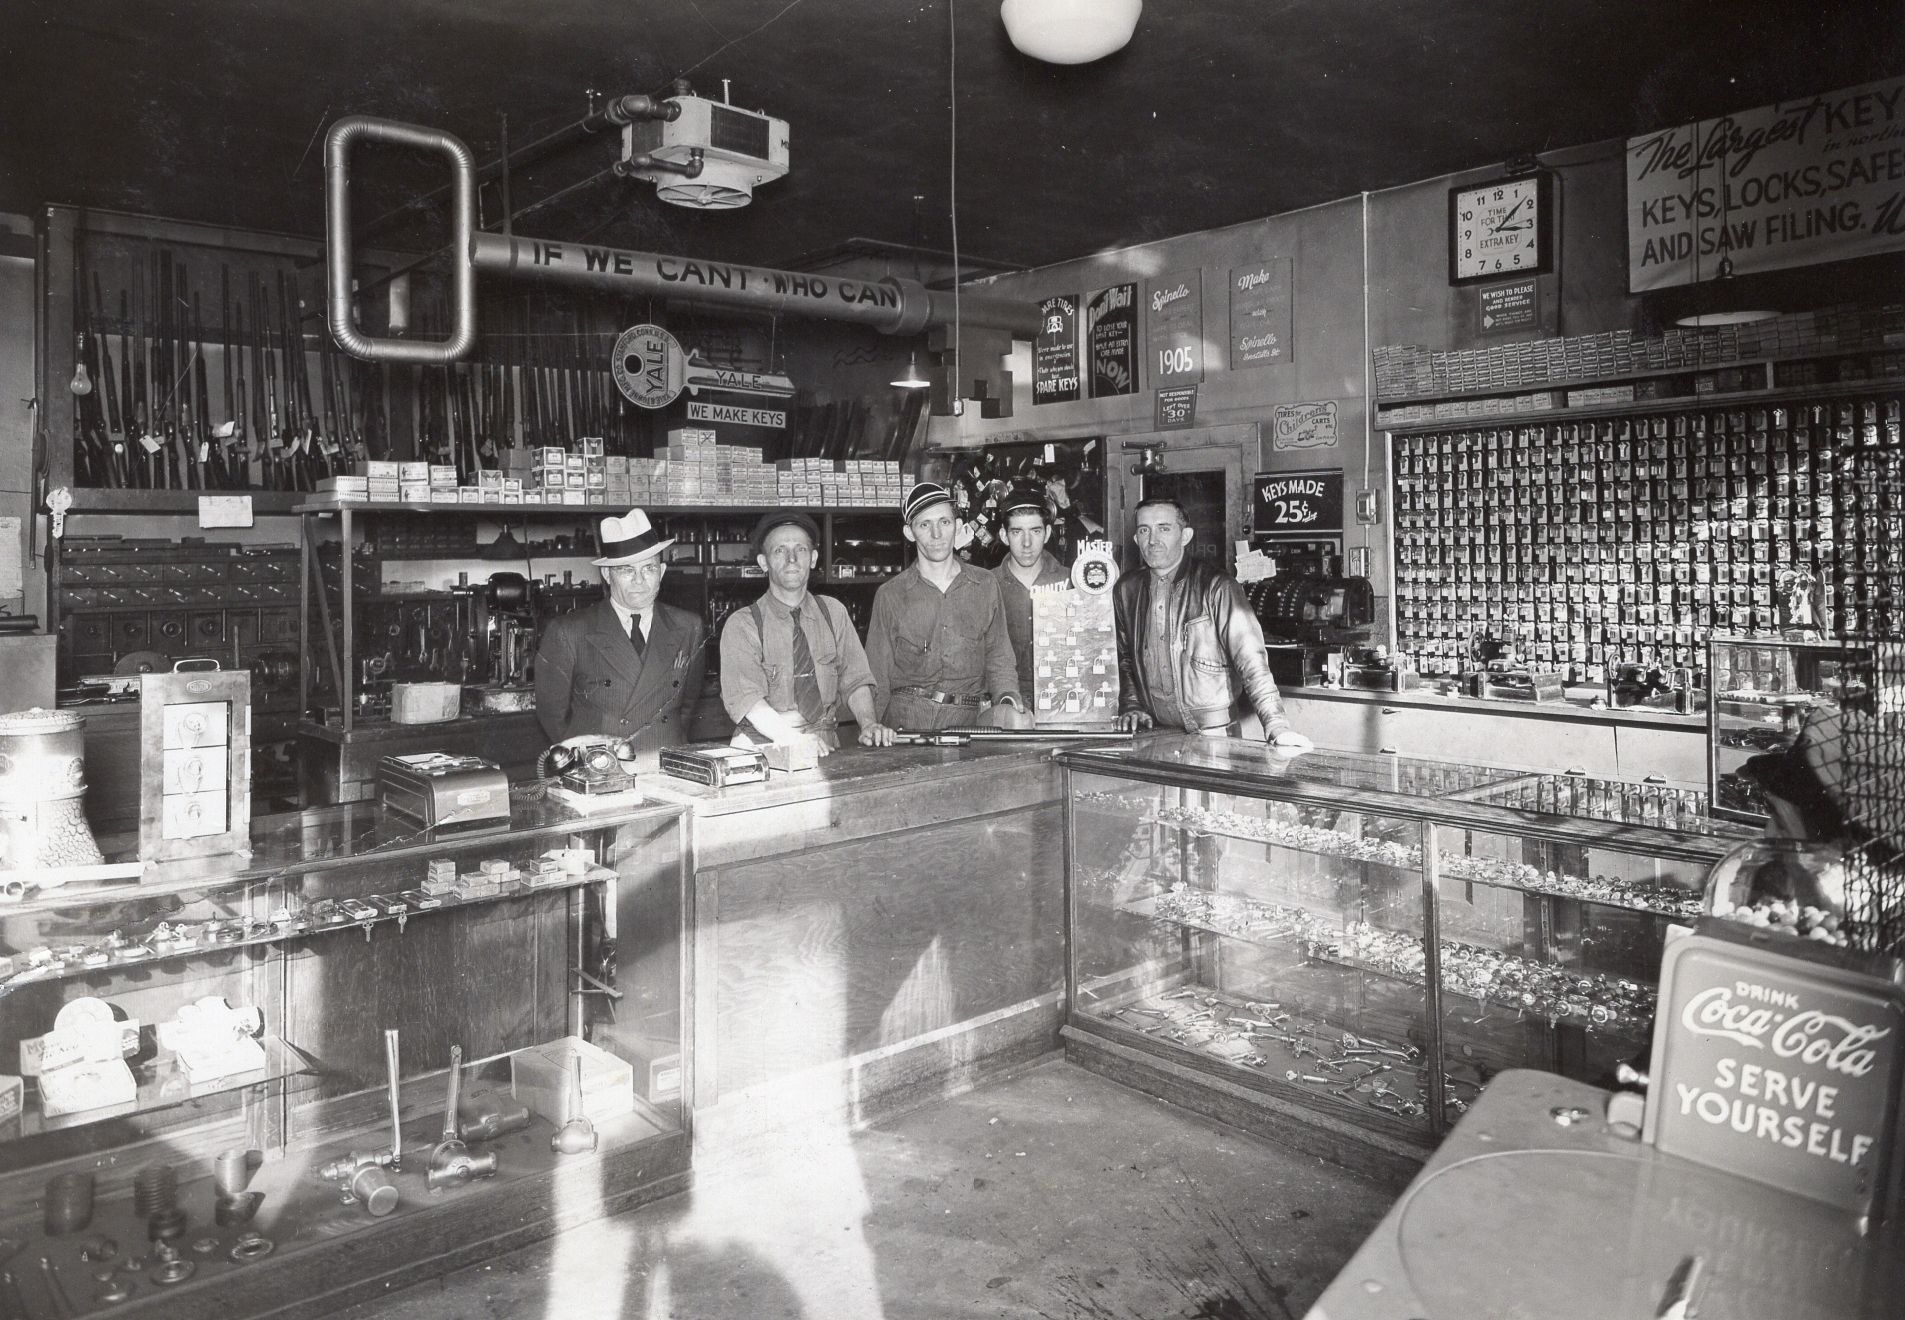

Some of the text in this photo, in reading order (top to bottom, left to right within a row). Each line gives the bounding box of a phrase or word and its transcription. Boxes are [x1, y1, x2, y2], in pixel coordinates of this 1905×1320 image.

[1636, 132, 1692, 180] The
[1678, 98, 1824, 179] Largest
[1493, 190, 1504, 201] 12
[1514, 189, 1518, 198] 1
[1642, 150, 1905, 228] KEYS, LOCKS, SAFE
[1477, 196, 1485, 206] 11
[1526, 199, 1534, 209] 2
[1462, 211, 1473, 222] 10
[1488, 207, 1507, 217] TIME
[1480, 216, 1495, 226] FOR
[1526, 219, 1534, 229] 3
[1465, 230, 1472, 240] 9
[1480, 233, 1519, 249] EXTRA KEY
[1641, 232, 1693, 267] AND
[1700, 220, 1757, 255] SAW
[1766, 201, 1867, 245] FILING.
[1526, 238, 1535, 248] 4
[1465, 249, 1472, 259] 8
[1514, 254, 1521, 265] 5
[1479, 260, 1487, 270] 7
[1495, 259, 1502, 270] 6
[533, 242, 562, 265] IF
[583, 247, 633, 275] WE
[772, 272, 828, 299] WHO
[839, 281, 898, 309] CAN
[1237, 269, 1270, 291] Make
[1108, 285, 1132, 311] Wait
[1152, 284, 1190, 312] Spinello
[1482, 284, 1534, 300] WE WISH TO PLEASE
[1057, 297, 1075, 316] TIRES
[1240, 333, 1277, 351] Spinello
[646, 340, 664, 397] YALE
[1159, 345, 1193, 375] 1905
[715, 370, 762, 390] YALE
[1096, 358, 1131, 389] NOW
[1036, 377, 1078, 394] SPARE KEYS
[690, 404, 784, 425] WE MAKE KEYS
[1163, 403, 1176, 411] LEFT
[1167, 409, 1186, 419] 30
[1278, 410, 1295, 418] TIRES
[1311, 417, 1331, 425] CARTS
[1262, 479, 1325, 502] KEYS MADE
[1077, 538, 1113, 558] MASTER
[1030, 578, 1070, 600] QUALITY
[1735, 980, 1799, 1010] DRINK
[1714, 1057, 1839, 1119] SERVE
[1676, 1083, 1874, 1166] YOURSELF
